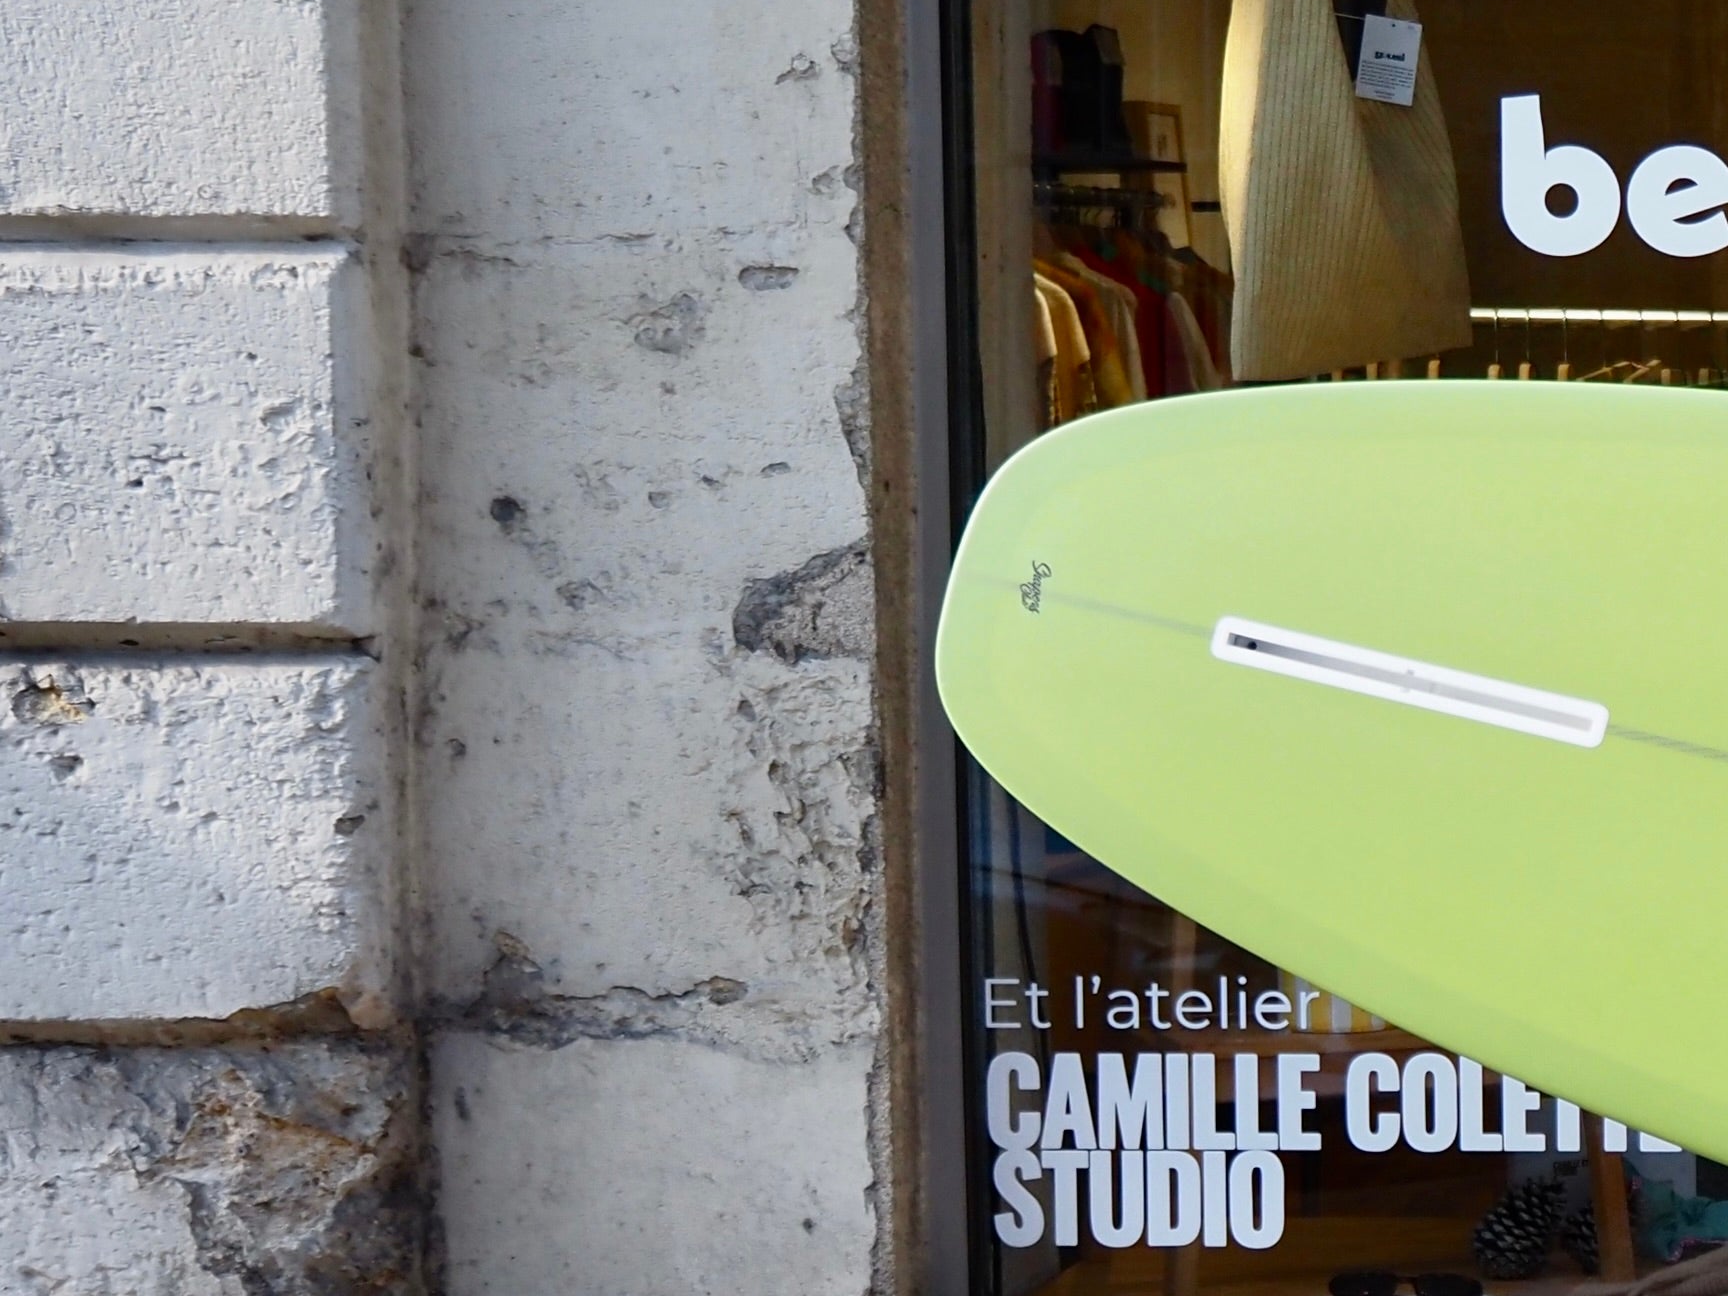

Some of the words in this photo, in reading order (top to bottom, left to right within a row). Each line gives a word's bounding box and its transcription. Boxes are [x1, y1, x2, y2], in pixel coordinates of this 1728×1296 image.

[984, 976, 1051, 1031] Et
[1075, 975, 1322, 1031] l'atelier
[987, 1051, 1322, 1152] CAMILLE
[1345, 1052, 1684, 1154] COLE
[992, 1148, 1286, 1250] STUDIO
